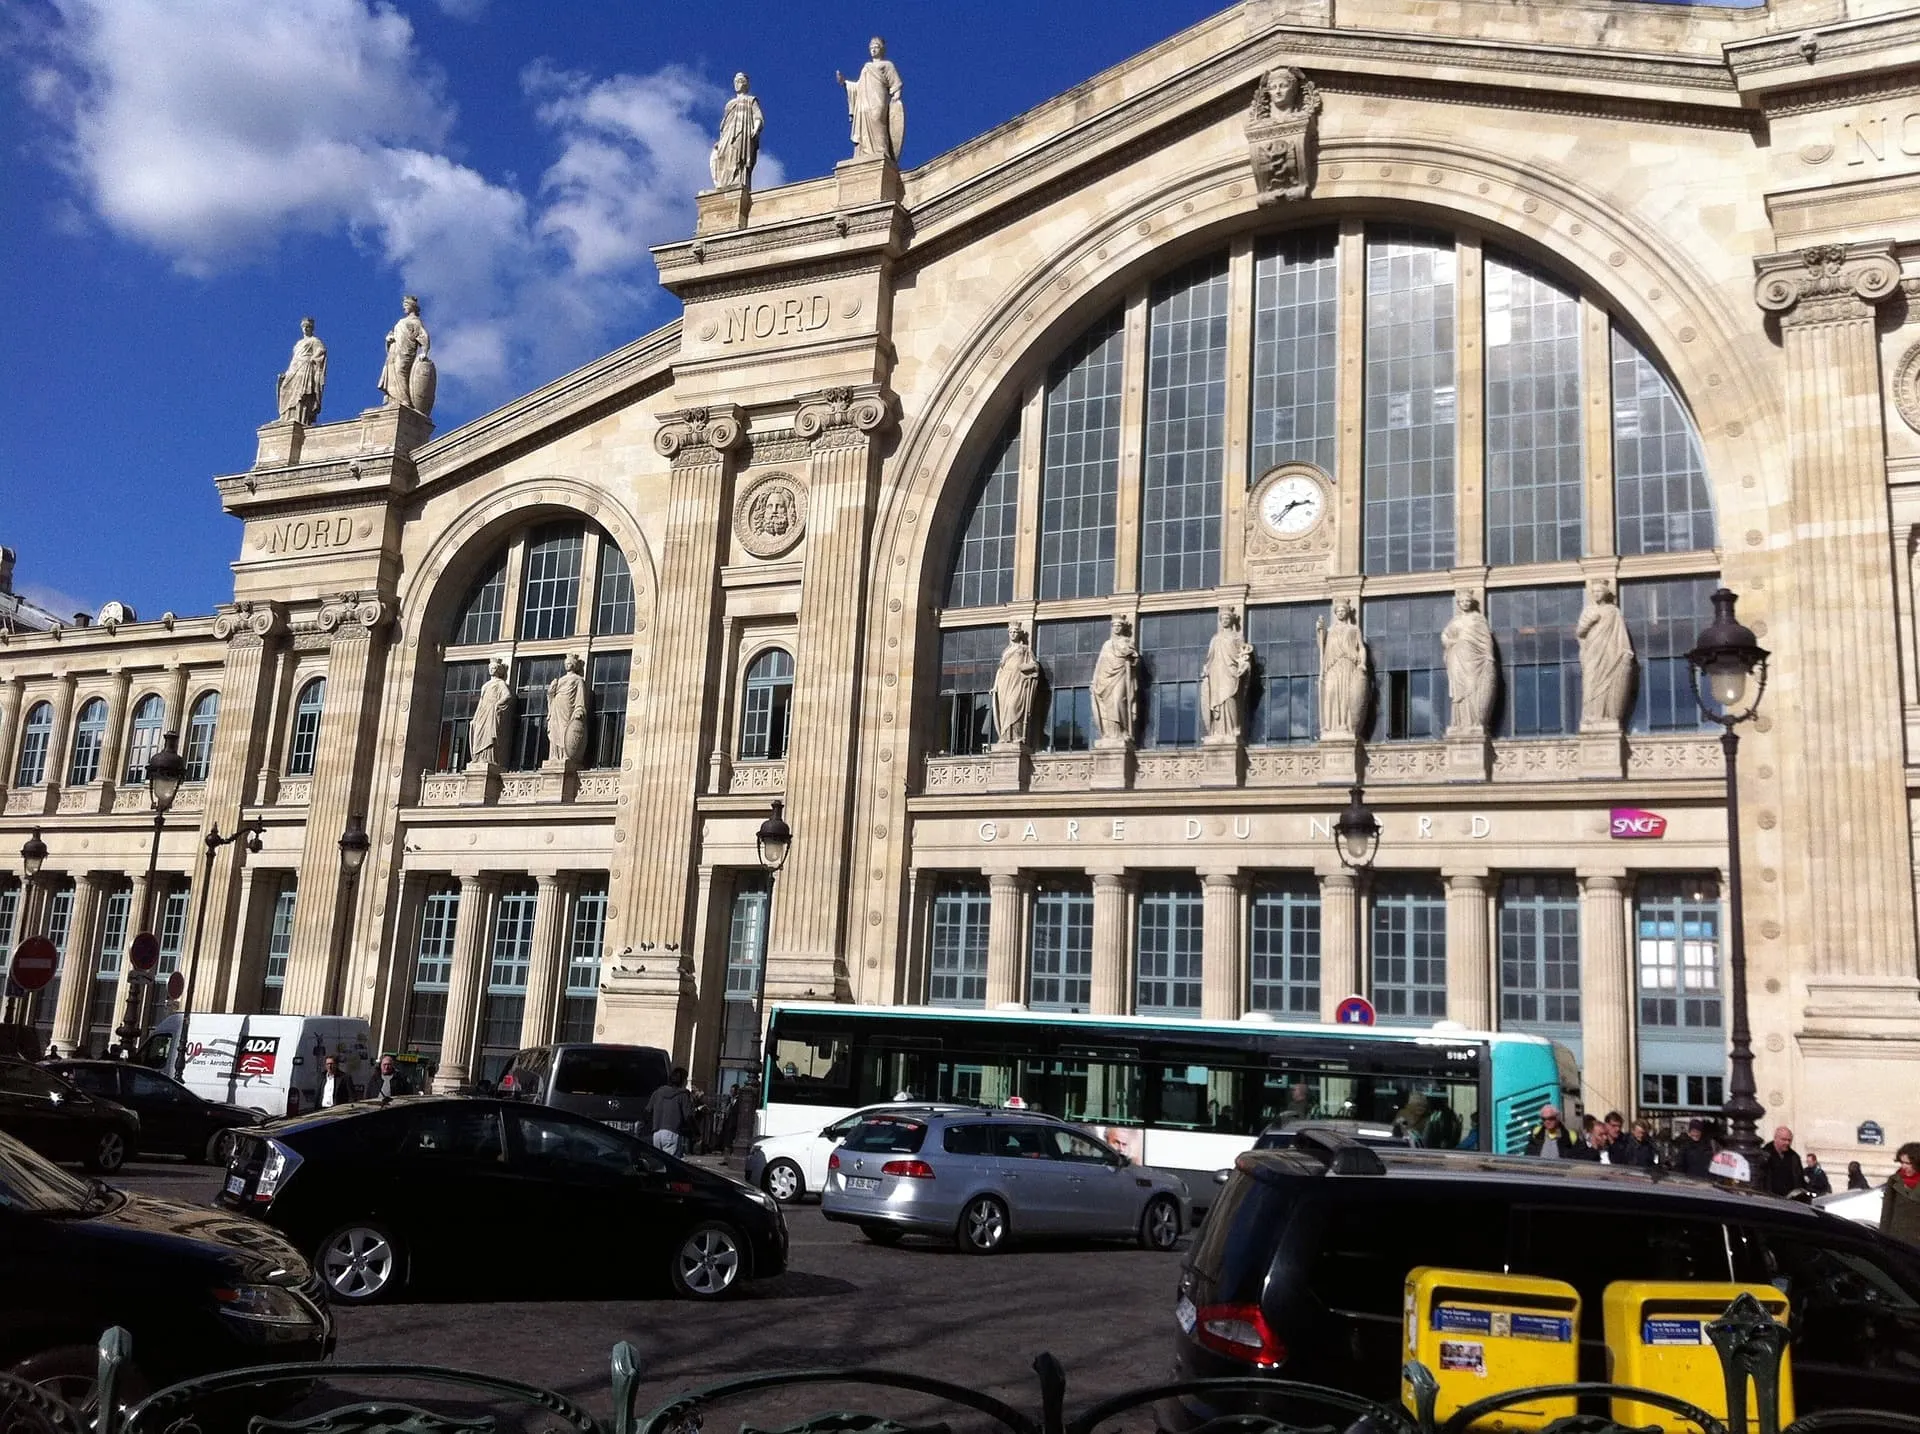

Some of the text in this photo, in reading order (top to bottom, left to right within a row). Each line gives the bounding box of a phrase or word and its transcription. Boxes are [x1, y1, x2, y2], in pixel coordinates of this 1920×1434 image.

[722, 295, 831, 344] NORD
[268, 517, 353, 554] NORD
[978, 815, 1491, 842] GARE DU NRD
[1612, 818, 1663, 833] SNCF
[243, 1039, 276, 1053] ADA
